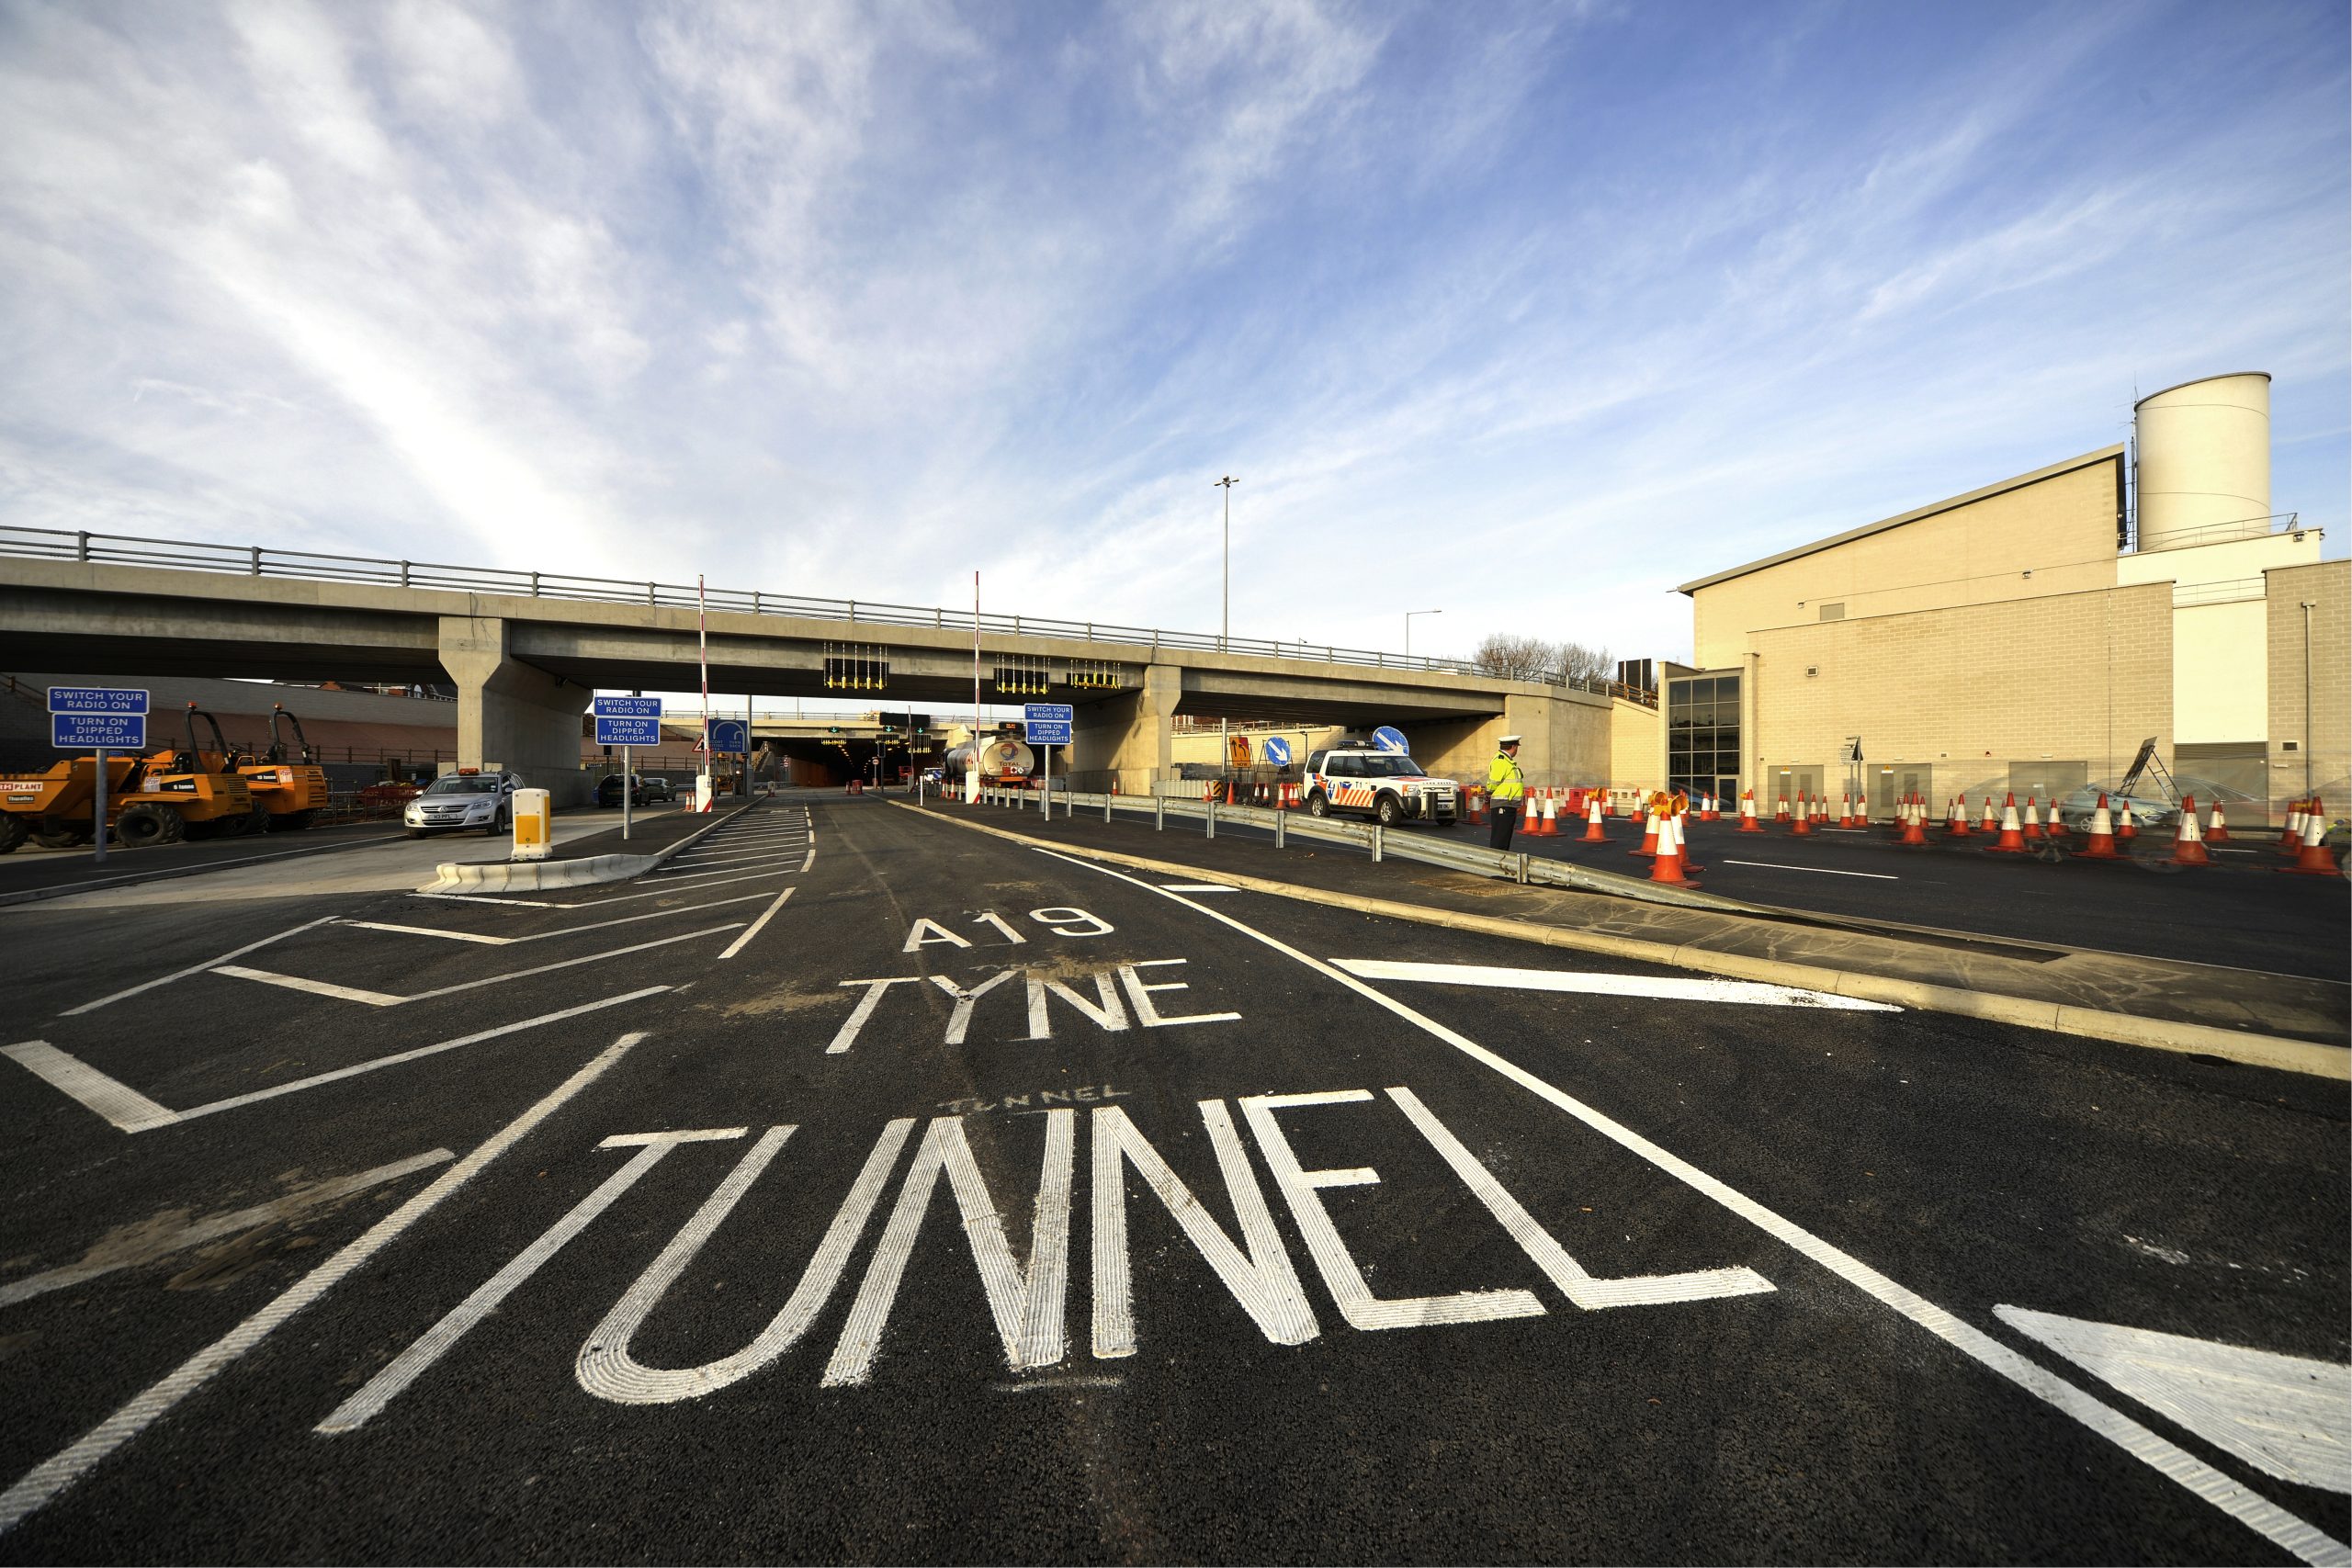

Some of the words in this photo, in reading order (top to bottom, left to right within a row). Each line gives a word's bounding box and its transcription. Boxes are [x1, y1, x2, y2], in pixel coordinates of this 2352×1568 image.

[54, 691, 104, 700] SWITCH
[108, 693, 142, 701] YOUR
[67, 700, 107, 709] RADIO
[111, 701, 130, 709] ON
[70, 717, 105, 726] TURN
[76, 727, 123, 735] DIPPED
[59, 735, 140, 744] HEADLIGHTS
[902, 907, 1114, 953] A19
[825, 958, 1242, 1054] TYNE
[312, 1086, 1778, 1435] TUNNEL
